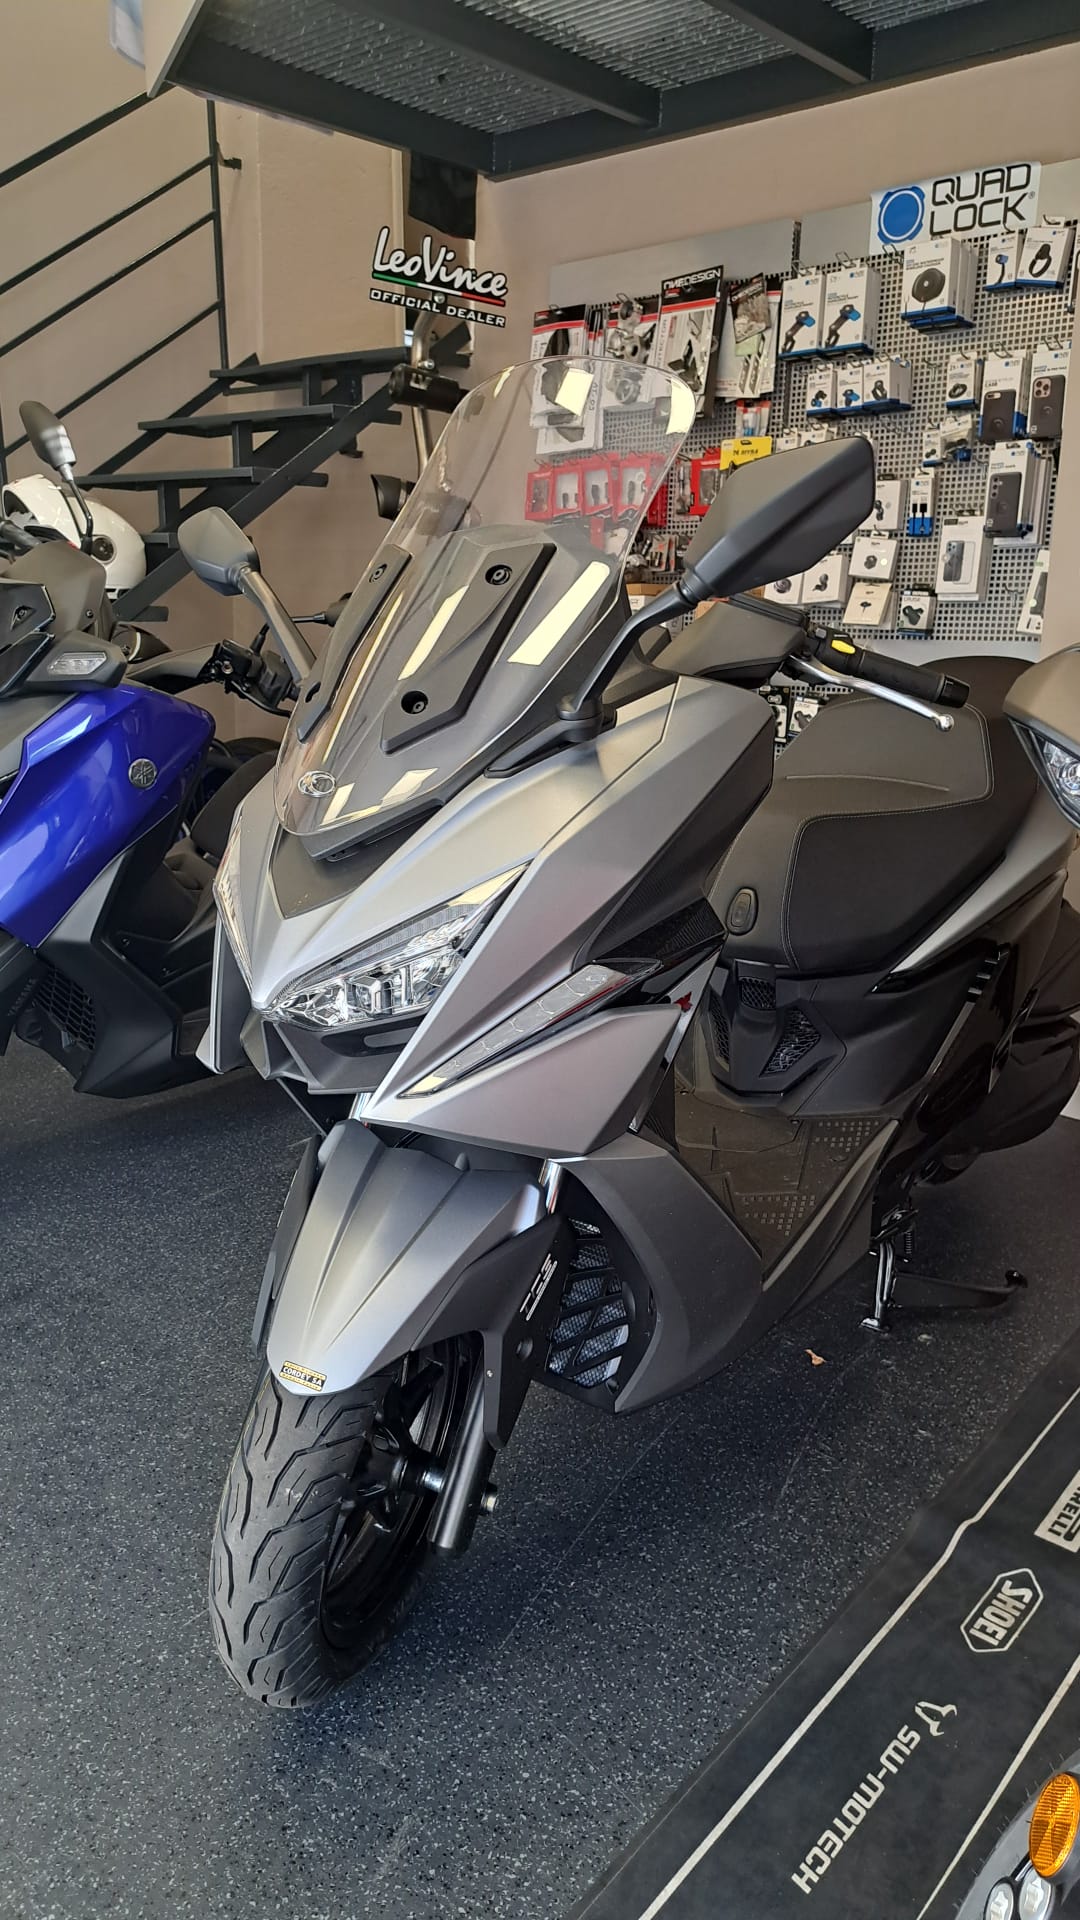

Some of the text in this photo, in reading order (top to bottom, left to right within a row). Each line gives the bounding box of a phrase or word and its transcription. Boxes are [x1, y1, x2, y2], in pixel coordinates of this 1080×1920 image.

[932, 163, 1032, 206] QUAD
[930, 193, 1029, 236] LOCK
[372, 226, 508, 297] LeoVince
[370, 289, 506, 327] OFFICIAL DEALER
[283, 1366, 310, 1382] CORDEY
[312, 1377, 322, 1386] SA
[969, 1580, 1033, 1646] SHOEI
[791, 1724, 921, 1895] SW-MOTECH
